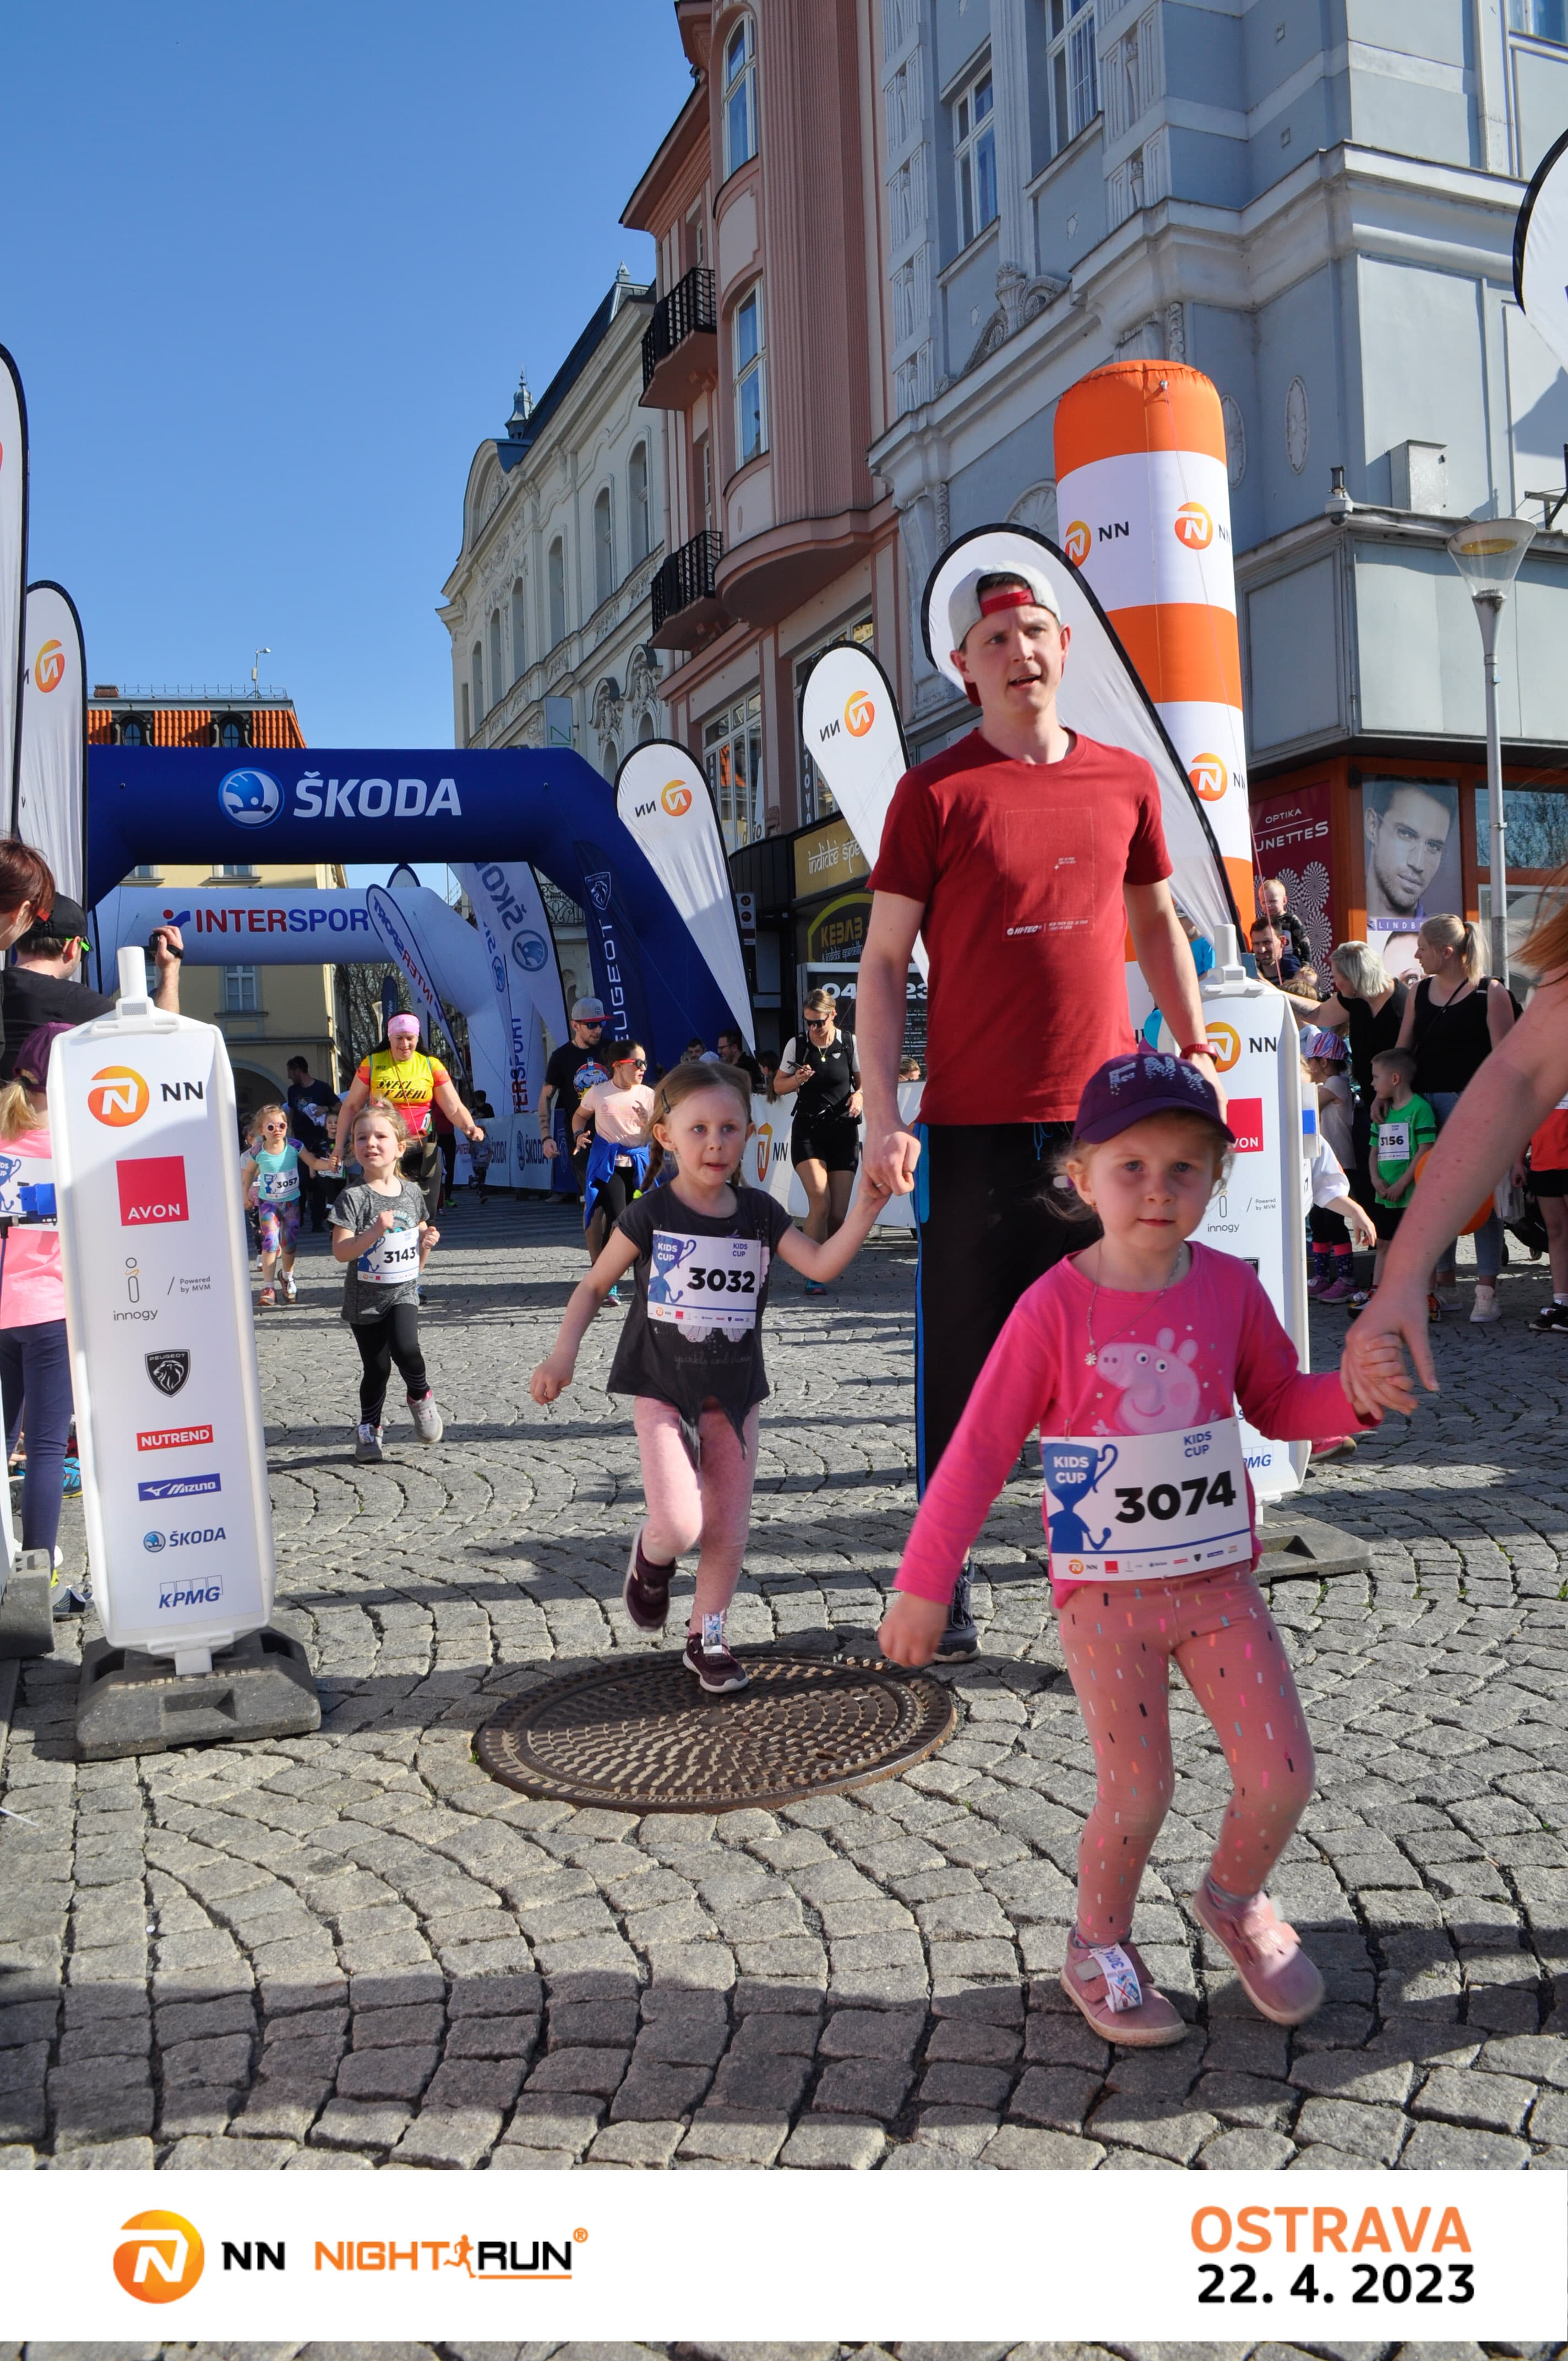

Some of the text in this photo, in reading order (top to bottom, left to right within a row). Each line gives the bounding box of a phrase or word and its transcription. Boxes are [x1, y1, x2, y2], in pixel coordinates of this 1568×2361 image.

[1098, 521, 1130, 542] NN
[293, 771, 461, 818] ŠKODA
[1265, 808, 1303, 825] OPTIKA
[1255, 820, 1330, 853] UNETTES
[195, 907, 369, 933] INTERSPOR
[1378, 921, 1423, 929] LINDB
[1014, 925, 1039, 935] HI-TEC
[1249, 1037, 1277, 1054] NN
[161, 1081, 204, 1102] NN
[1380, 1135, 1404, 1147] 3156
[772, 1142, 788, 1161] NN
[276, 1177, 298, 1189] 3057
[127, 1203, 181, 1221] AVON
[1207, 1222, 1240, 1234] innogy
[657, 1242, 678, 1253] KIDS
[383, 1247, 416, 1264] 3143
[657, 1253, 676, 1262] CUP
[179, 1276, 211, 1285] Powered
[687, 1267, 755, 1293] 3032
[180, 1283, 211, 1294] by MVM
[113, 1309, 158, 1321] innogy
[148, 1352, 187, 1361] PEUGEOT
[141, 1428, 210, 1447] NUTREND
[1183, 1431, 1212, 1445] KIDS
[1184, 1444, 1210, 1458] CUP
[1053, 1455, 1090, 1469] KIDS
[1055, 1471, 1087, 1485] CUP
[1115, 1470, 1237, 1524] 3074
[169, 1526, 226, 1548] ŠKODA
[159, 1585, 220, 1609] KPMG
